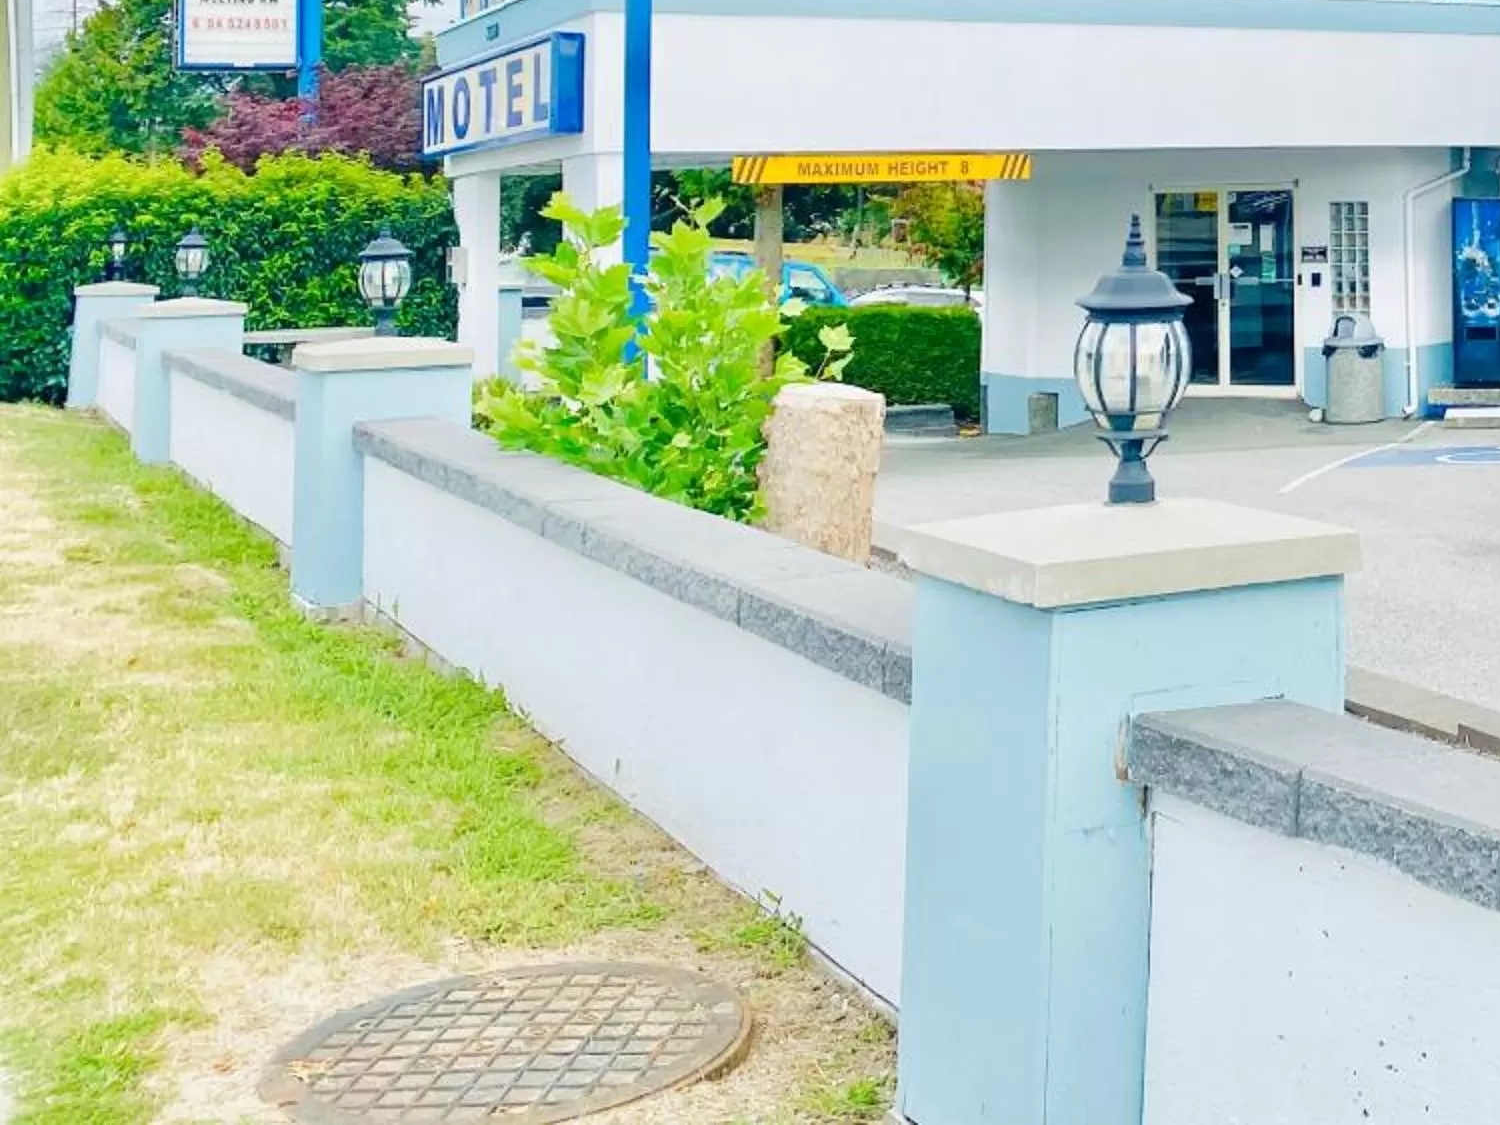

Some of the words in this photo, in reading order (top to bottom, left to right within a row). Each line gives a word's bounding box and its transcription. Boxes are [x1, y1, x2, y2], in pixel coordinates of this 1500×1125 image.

[427, 51, 548, 147] MOTEL
[797, 161, 879, 176] MAXIMUM
[887, 160, 950, 175] HEIGHT
